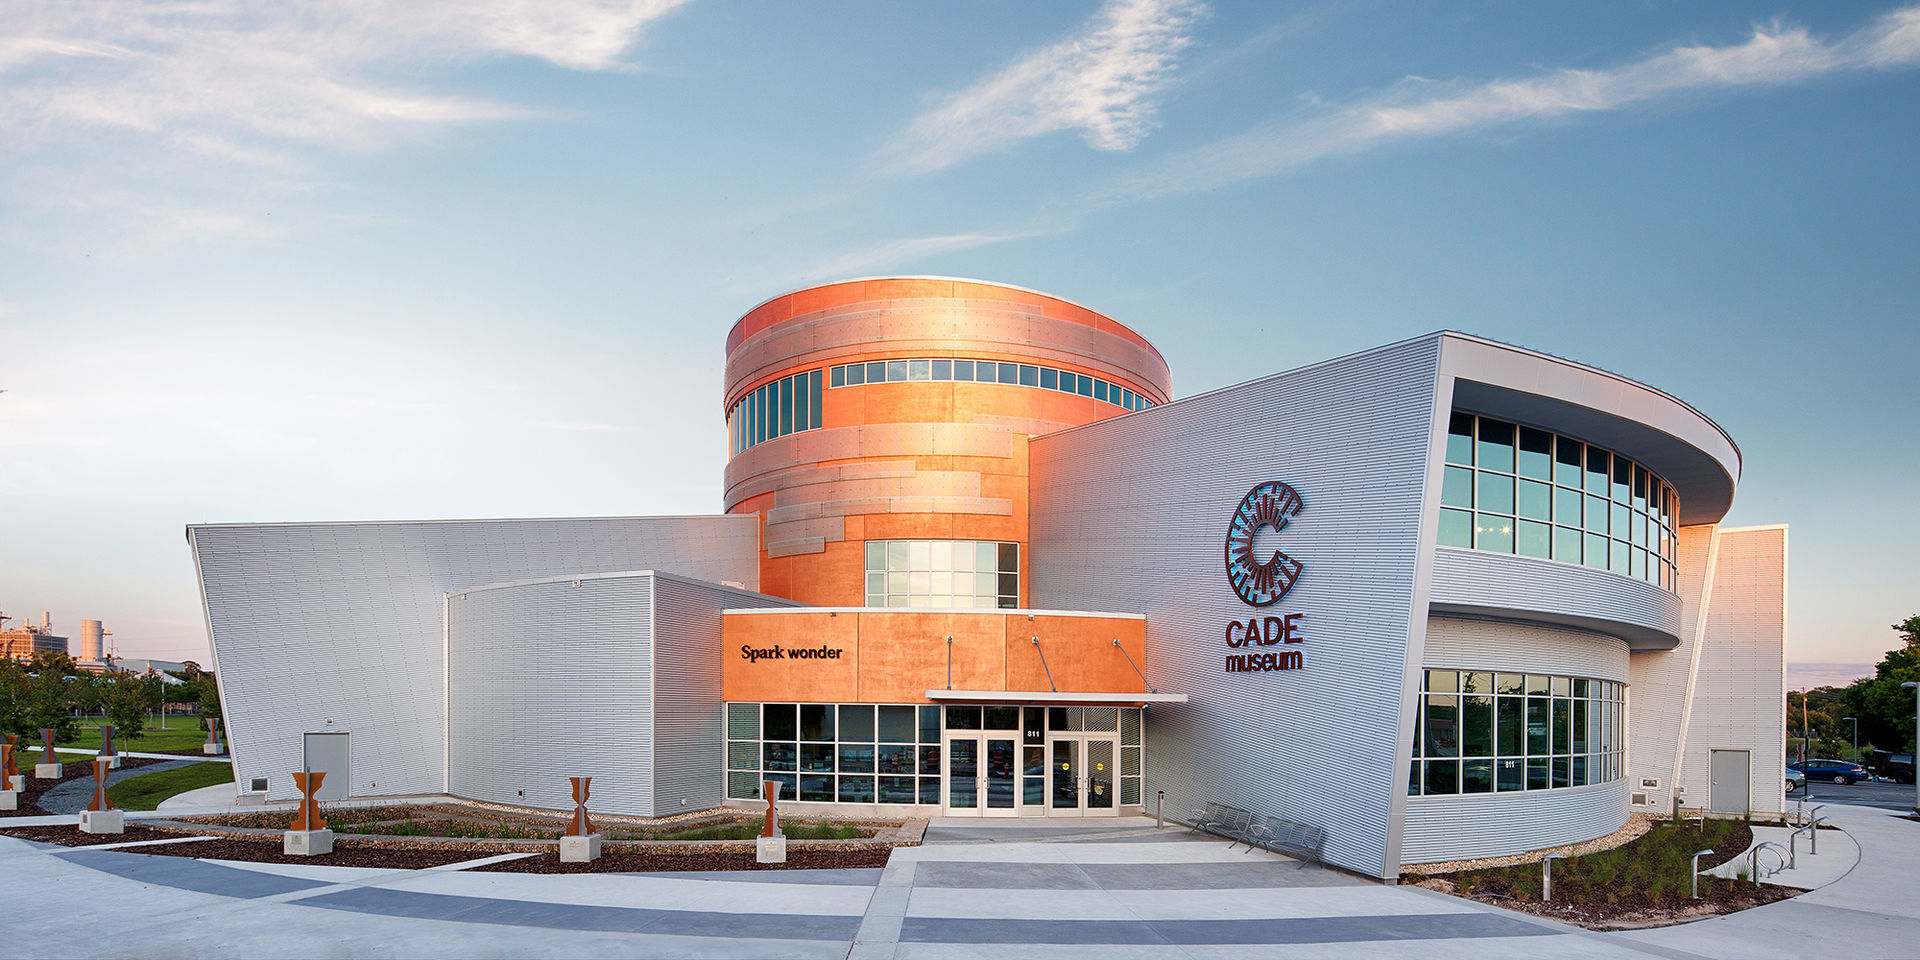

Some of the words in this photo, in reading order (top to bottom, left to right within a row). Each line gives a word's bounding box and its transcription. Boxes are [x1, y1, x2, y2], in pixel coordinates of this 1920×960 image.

[1225, 612, 1304, 648] CADE
[741, 644, 785, 663] Spark
[787, 644, 843, 659] wonder
[1225, 650, 1303, 673] museum
[1027, 730, 1040, 738] 811
[1505, 760, 1515, 769] 811
